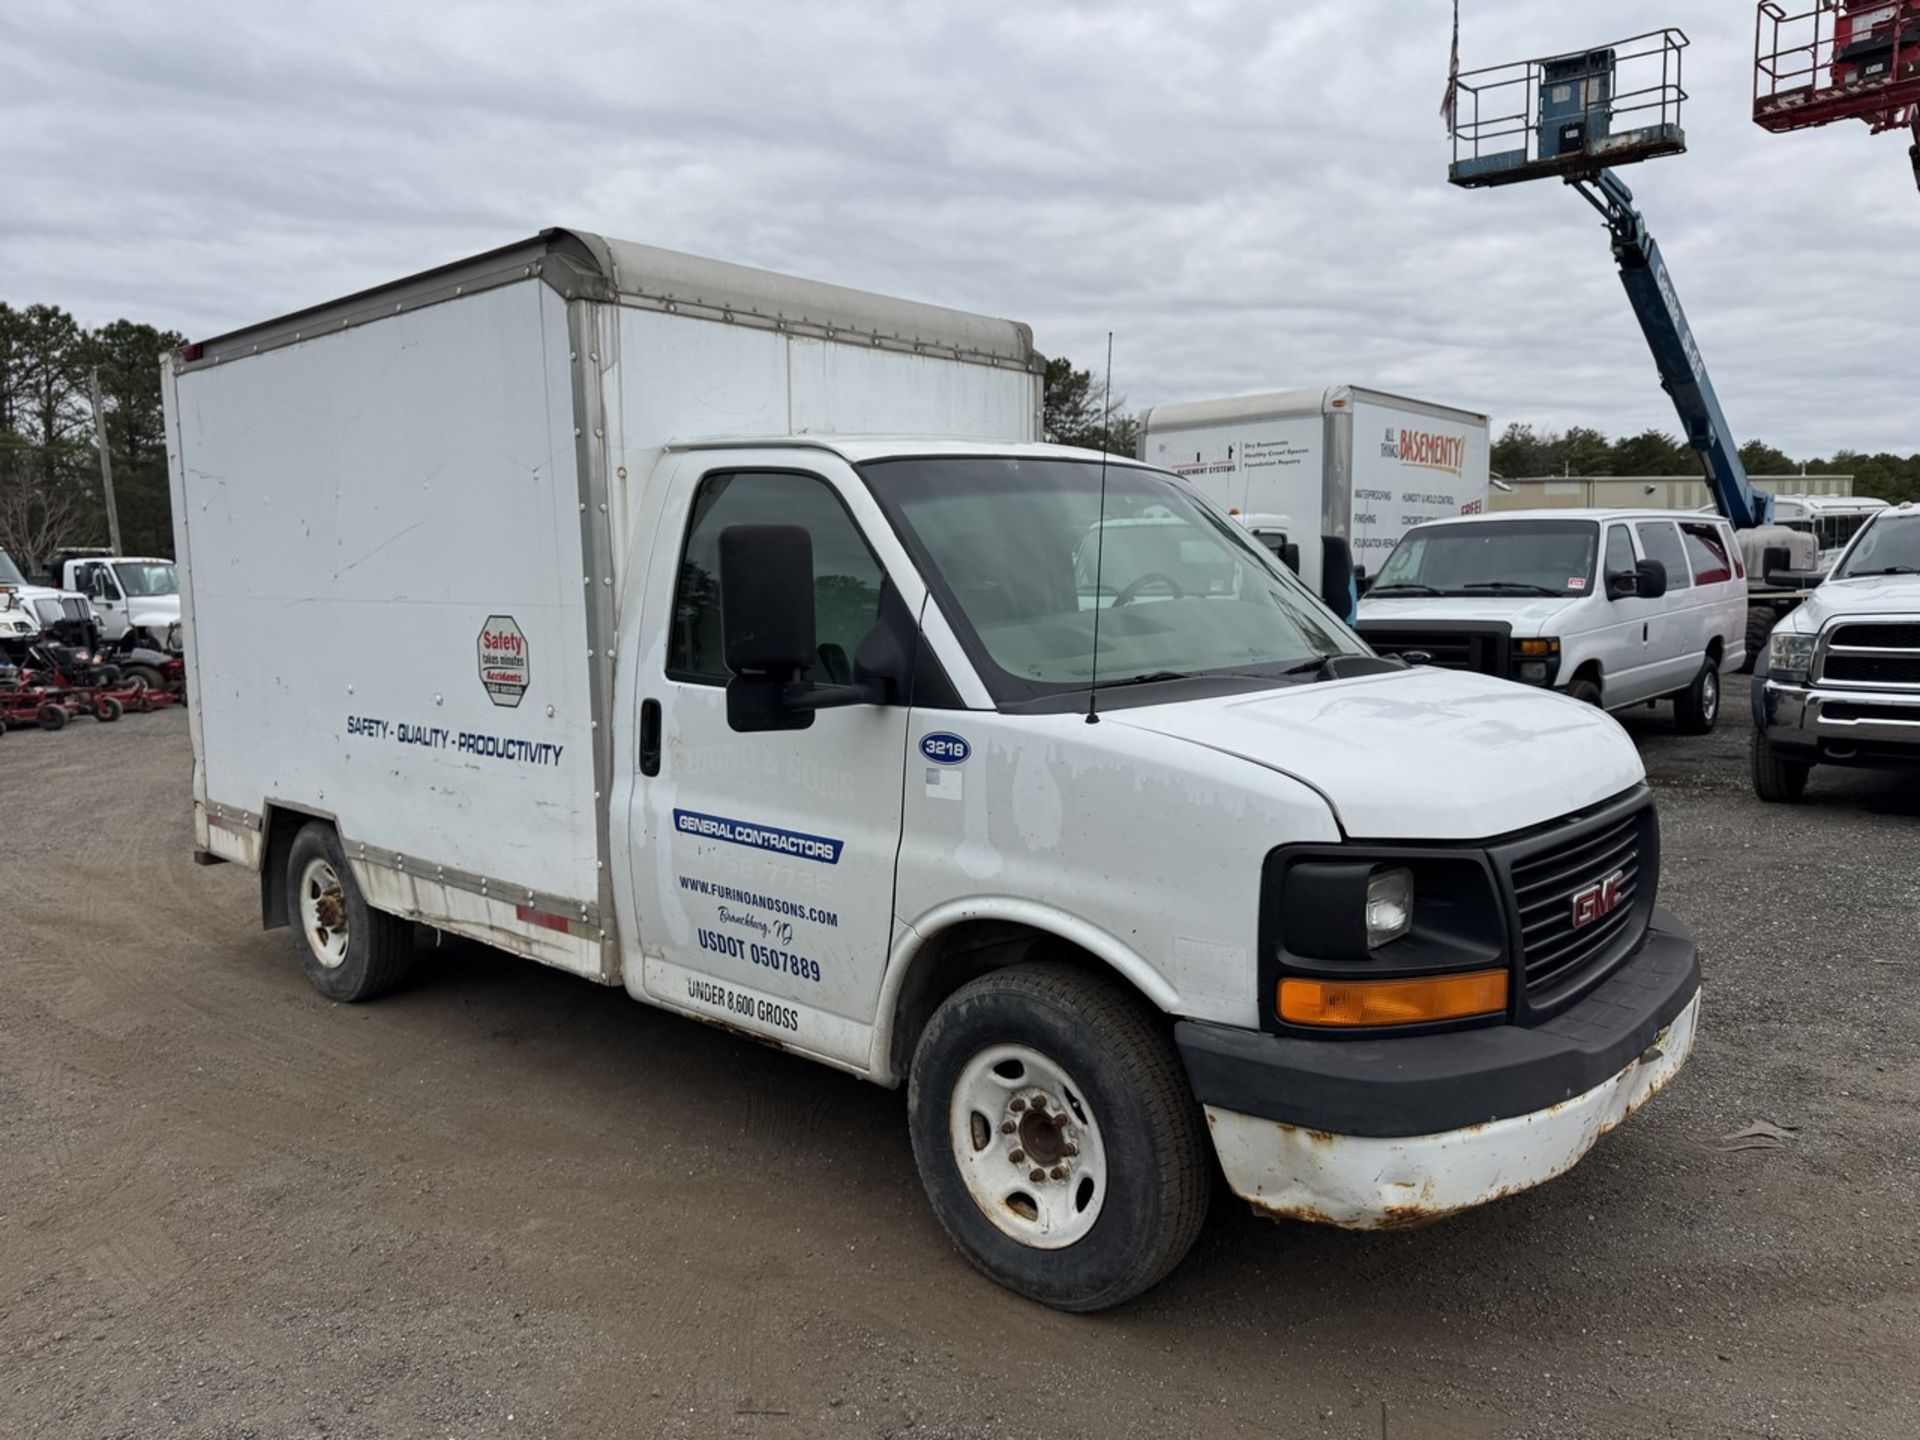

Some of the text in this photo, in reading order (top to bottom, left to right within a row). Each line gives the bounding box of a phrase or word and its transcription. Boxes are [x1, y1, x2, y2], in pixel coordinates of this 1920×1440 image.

[1208, 464, 1236, 474] SYSTEMS
[482, 653, 524, 667] takes minutes
[483, 630, 522, 656] Safety
[486, 670, 522, 683] Accidents
[347, 715, 389, 739] SAFETY
[397, 723, 450, 749] QUALITY
[458, 732, 564, 767] PRODUCTIVITY
[925, 740, 964, 757] 3218
[679, 815, 834, 860] GENERAL CONTRACTORS
[678, 875, 839, 928] WWW.FURINOANDSONS.COM
[1573, 870, 1624, 930] GMC
[773, 920, 793, 946] NJ
[698, 928, 821, 982] USDOT 0507889
[686, 977, 799, 1032] UNDER 8,600 GROSS
